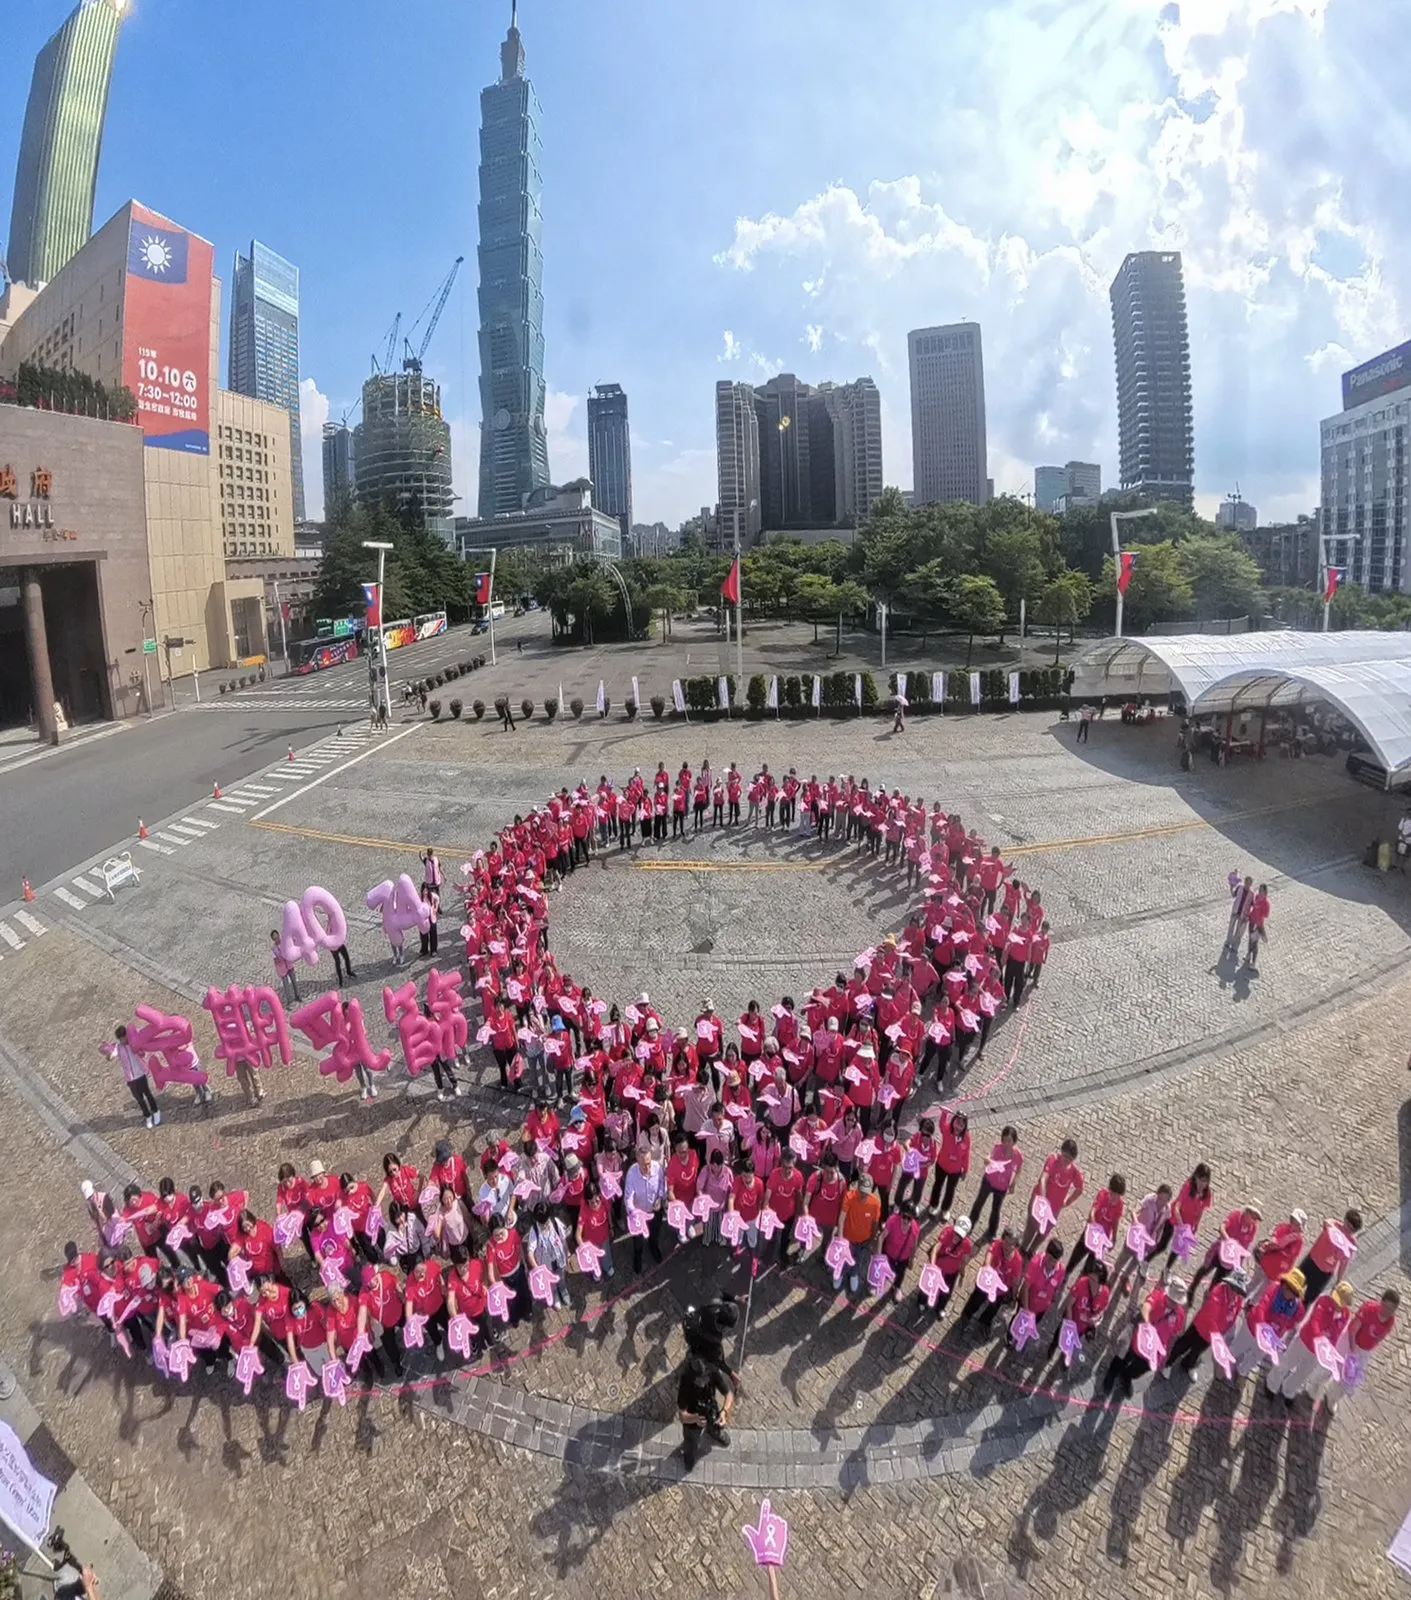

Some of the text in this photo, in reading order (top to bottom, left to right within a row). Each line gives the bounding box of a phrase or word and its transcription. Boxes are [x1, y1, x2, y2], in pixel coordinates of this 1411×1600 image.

[138, 358, 181, 388] 10.10
[12, 503, 55, 523] HALL
[281, 886, 347, 966] 40
